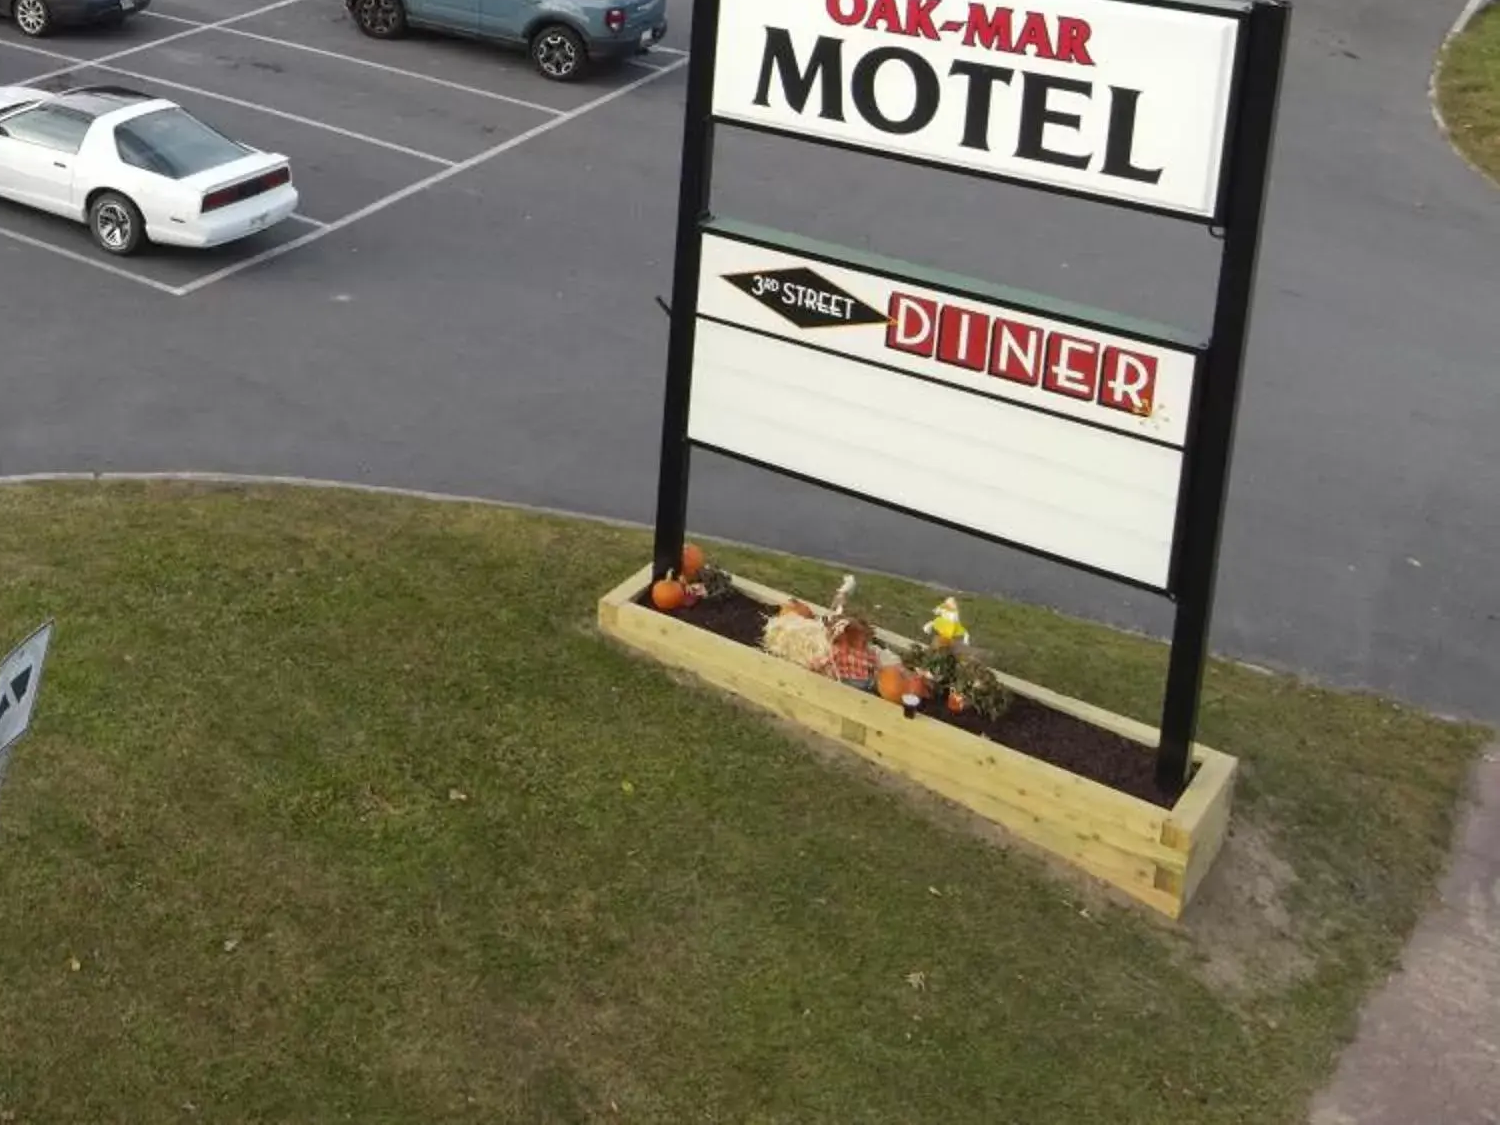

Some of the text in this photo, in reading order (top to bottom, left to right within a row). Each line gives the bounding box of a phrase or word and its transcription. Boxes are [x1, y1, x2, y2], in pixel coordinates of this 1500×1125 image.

[752, 26, 1163, 183] MOTEL
[751, 275, 855, 319] 3RD STREET
[895, 298, 1152, 408] DINER
